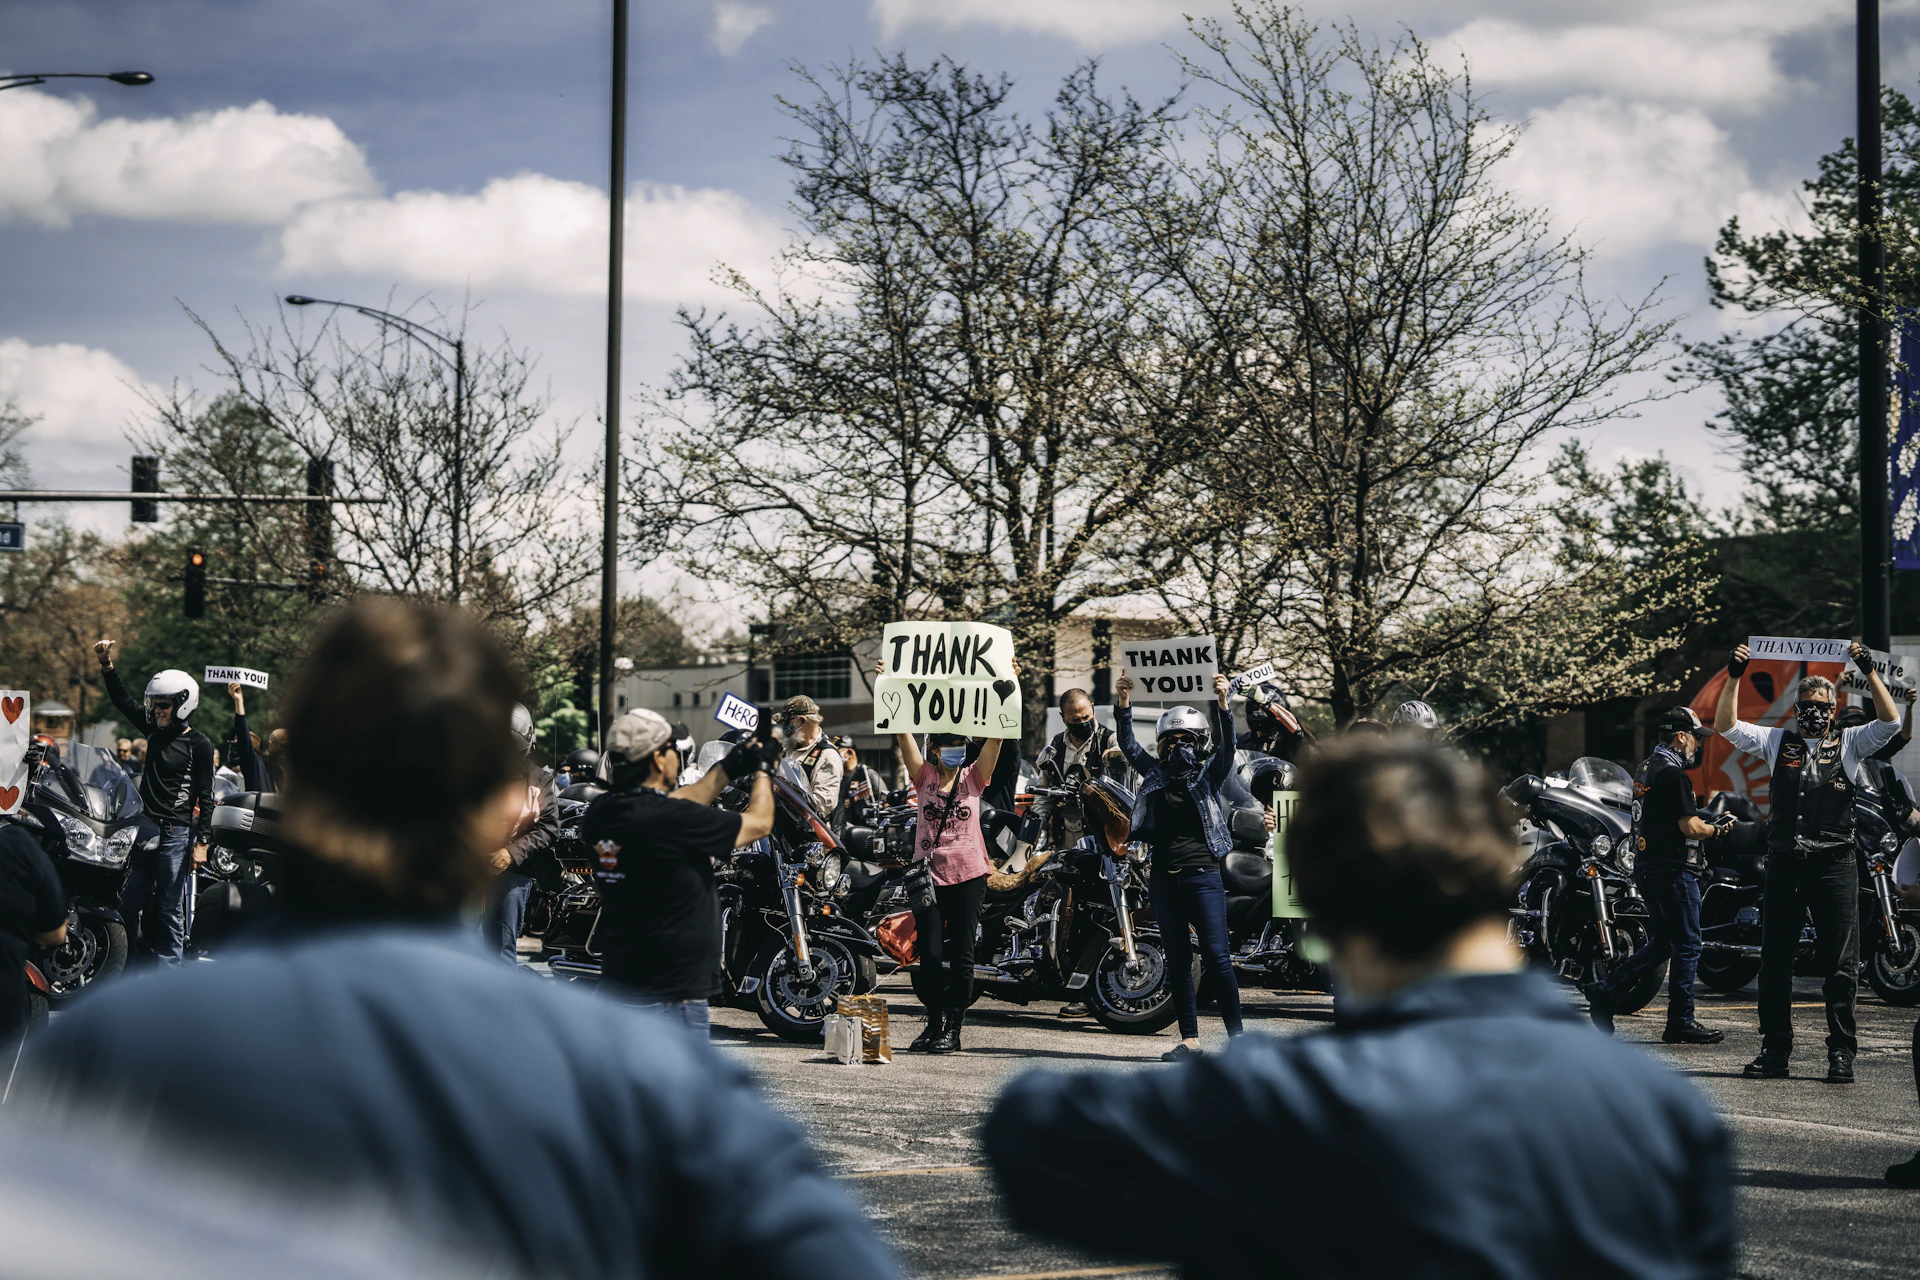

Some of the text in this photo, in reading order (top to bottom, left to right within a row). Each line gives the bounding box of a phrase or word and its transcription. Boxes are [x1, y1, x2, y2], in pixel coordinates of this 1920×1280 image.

[890, 633, 996, 677] THANK
[1125, 646, 1213, 667] THANK
[1756, 640, 1844, 656] THANK YOU!
[207, 669, 266, 684] THANK YOU!
[1246, 666, 1272, 681] YOU!
[1140, 675, 1204, 693] YOU!
[907, 682, 988, 726] YOU!!
[724, 700, 759, 728] HERO
